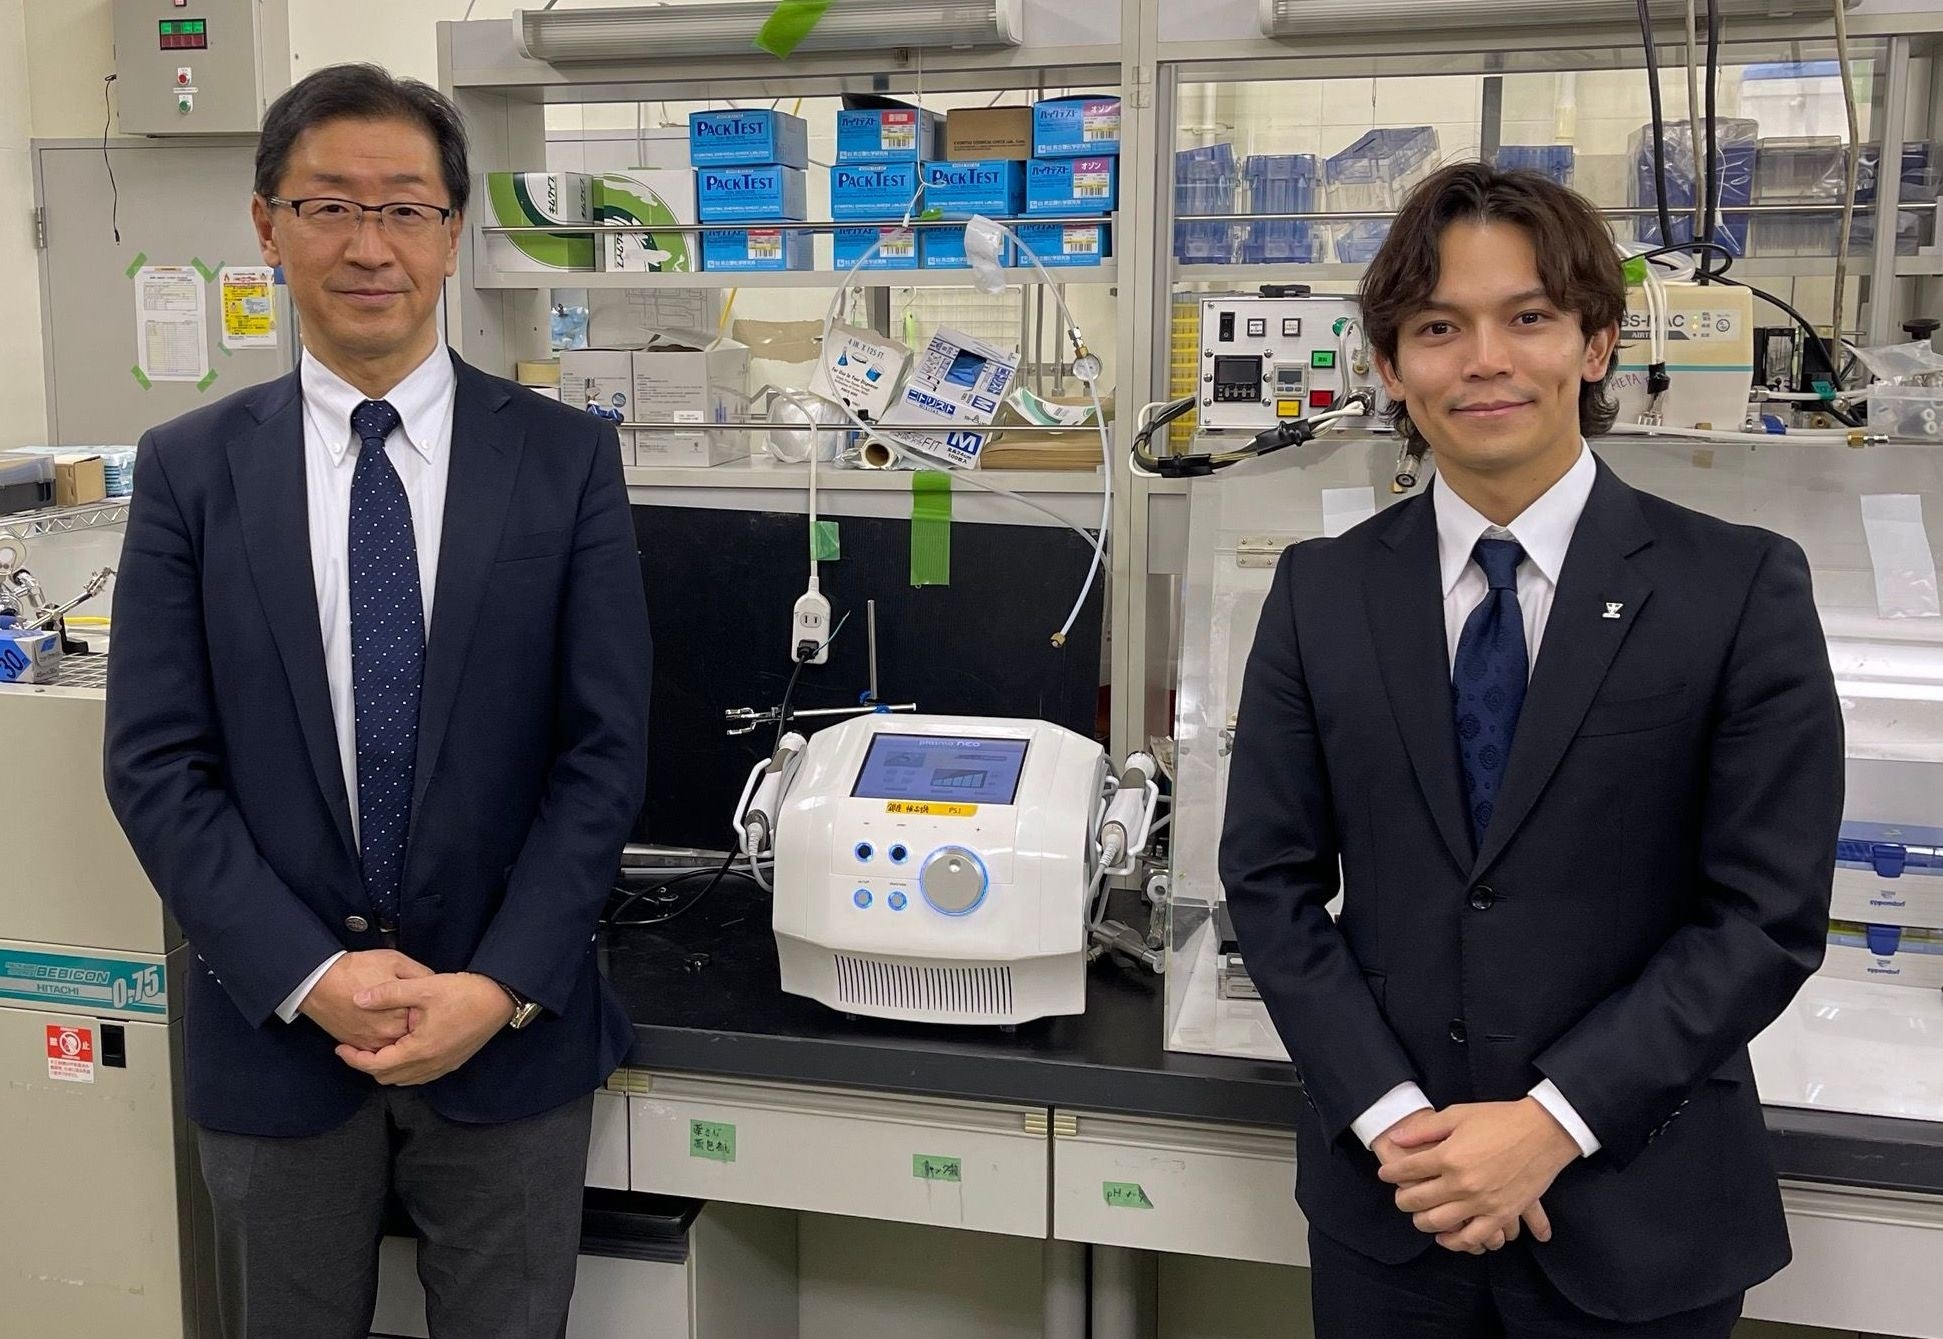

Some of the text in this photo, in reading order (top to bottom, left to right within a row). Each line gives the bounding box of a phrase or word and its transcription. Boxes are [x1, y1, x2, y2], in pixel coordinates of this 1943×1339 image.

[1090, 104, 1113, 113] オゾン
[1081, 161, 1102, 170] オゾン
[1611, 372, 1641, 391] HEPA
[908, 389, 956, 415] ニトリスト
[951, 432, 978, 453] M
[1869, 899, 1906, 907] eppendorf
[1866, 967, 1900, 975] eppendorf
[35, 966, 160, 1008] BEBICON 0.75
[36, 983, 79, 995] HITACHI
